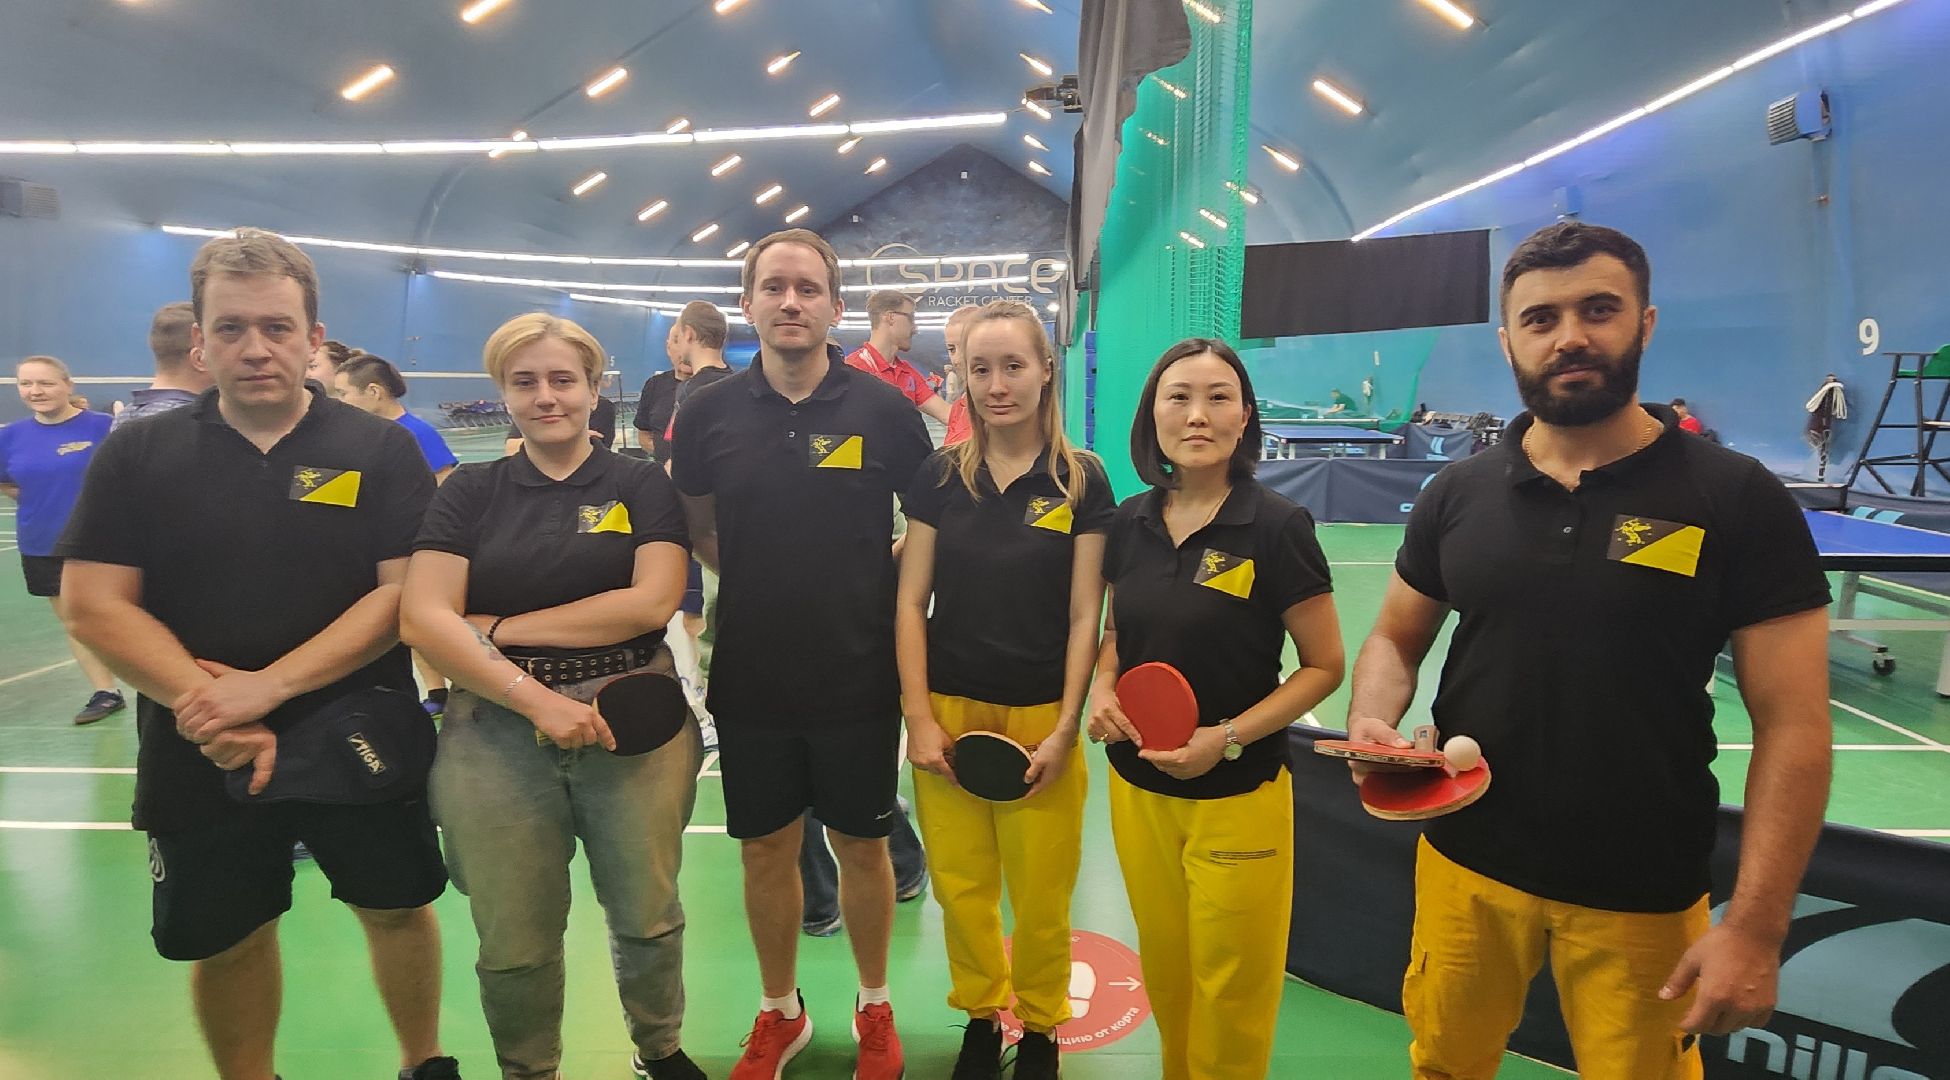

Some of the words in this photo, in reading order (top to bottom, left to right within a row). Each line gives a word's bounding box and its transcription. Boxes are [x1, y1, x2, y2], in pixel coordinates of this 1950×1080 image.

[928, 295, 978, 307] RACKET
[1859, 318, 1879, 355] 9
[348, 737, 383, 772] STIGA
[1094, 1028, 1111, 1039] от
[1110, 1006, 1141, 1032] корта
